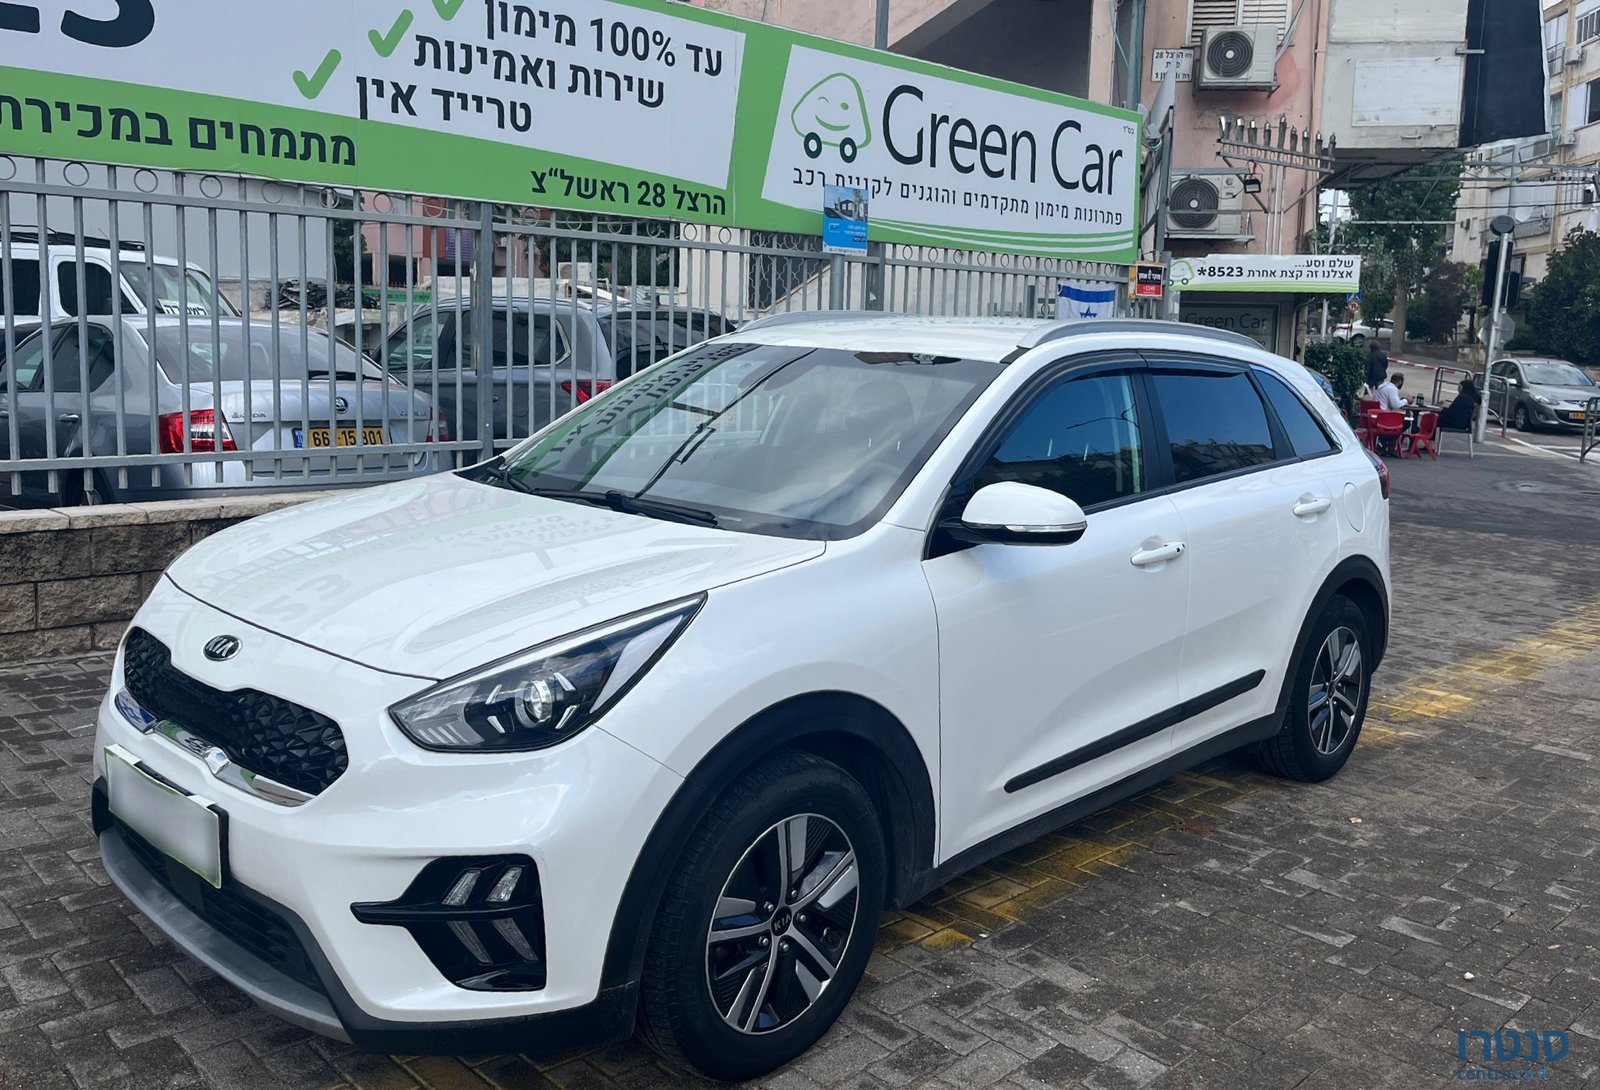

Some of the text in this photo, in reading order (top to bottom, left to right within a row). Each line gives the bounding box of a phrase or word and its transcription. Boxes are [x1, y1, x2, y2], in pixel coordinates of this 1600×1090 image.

[484, 0, 723, 77] עד 100% מימון
[413, 34, 665, 108] שירות ואמינות
[355, 75, 532, 133] טרייד אין
[0, 95, 356, 166] מתמחים במכירת
[882, 84, 1124, 196] Green Car
[793, 167, 826, 187] רכב
[637, 181, 667, 208] 28
[673, 184, 727, 216] הרצל
[900, 183, 956, 205] והוגנים
[963, 191, 1029, 215] מתקדמים
[1035, 201, 1069, 220] מימון
[1074, 206, 1122, 225] פתרונות
[1328, 258, 1354, 267] שלם
[1247, 270, 1277, 278] אחרת
[1279, 269, 1303, 280] קצת
[1306, 270, 1318, 278] זה
[1322, 269, 1353, 279] אצלנו
[1239, 313, 1268, 328] Car
[205, 636, 235, 657] KIA
